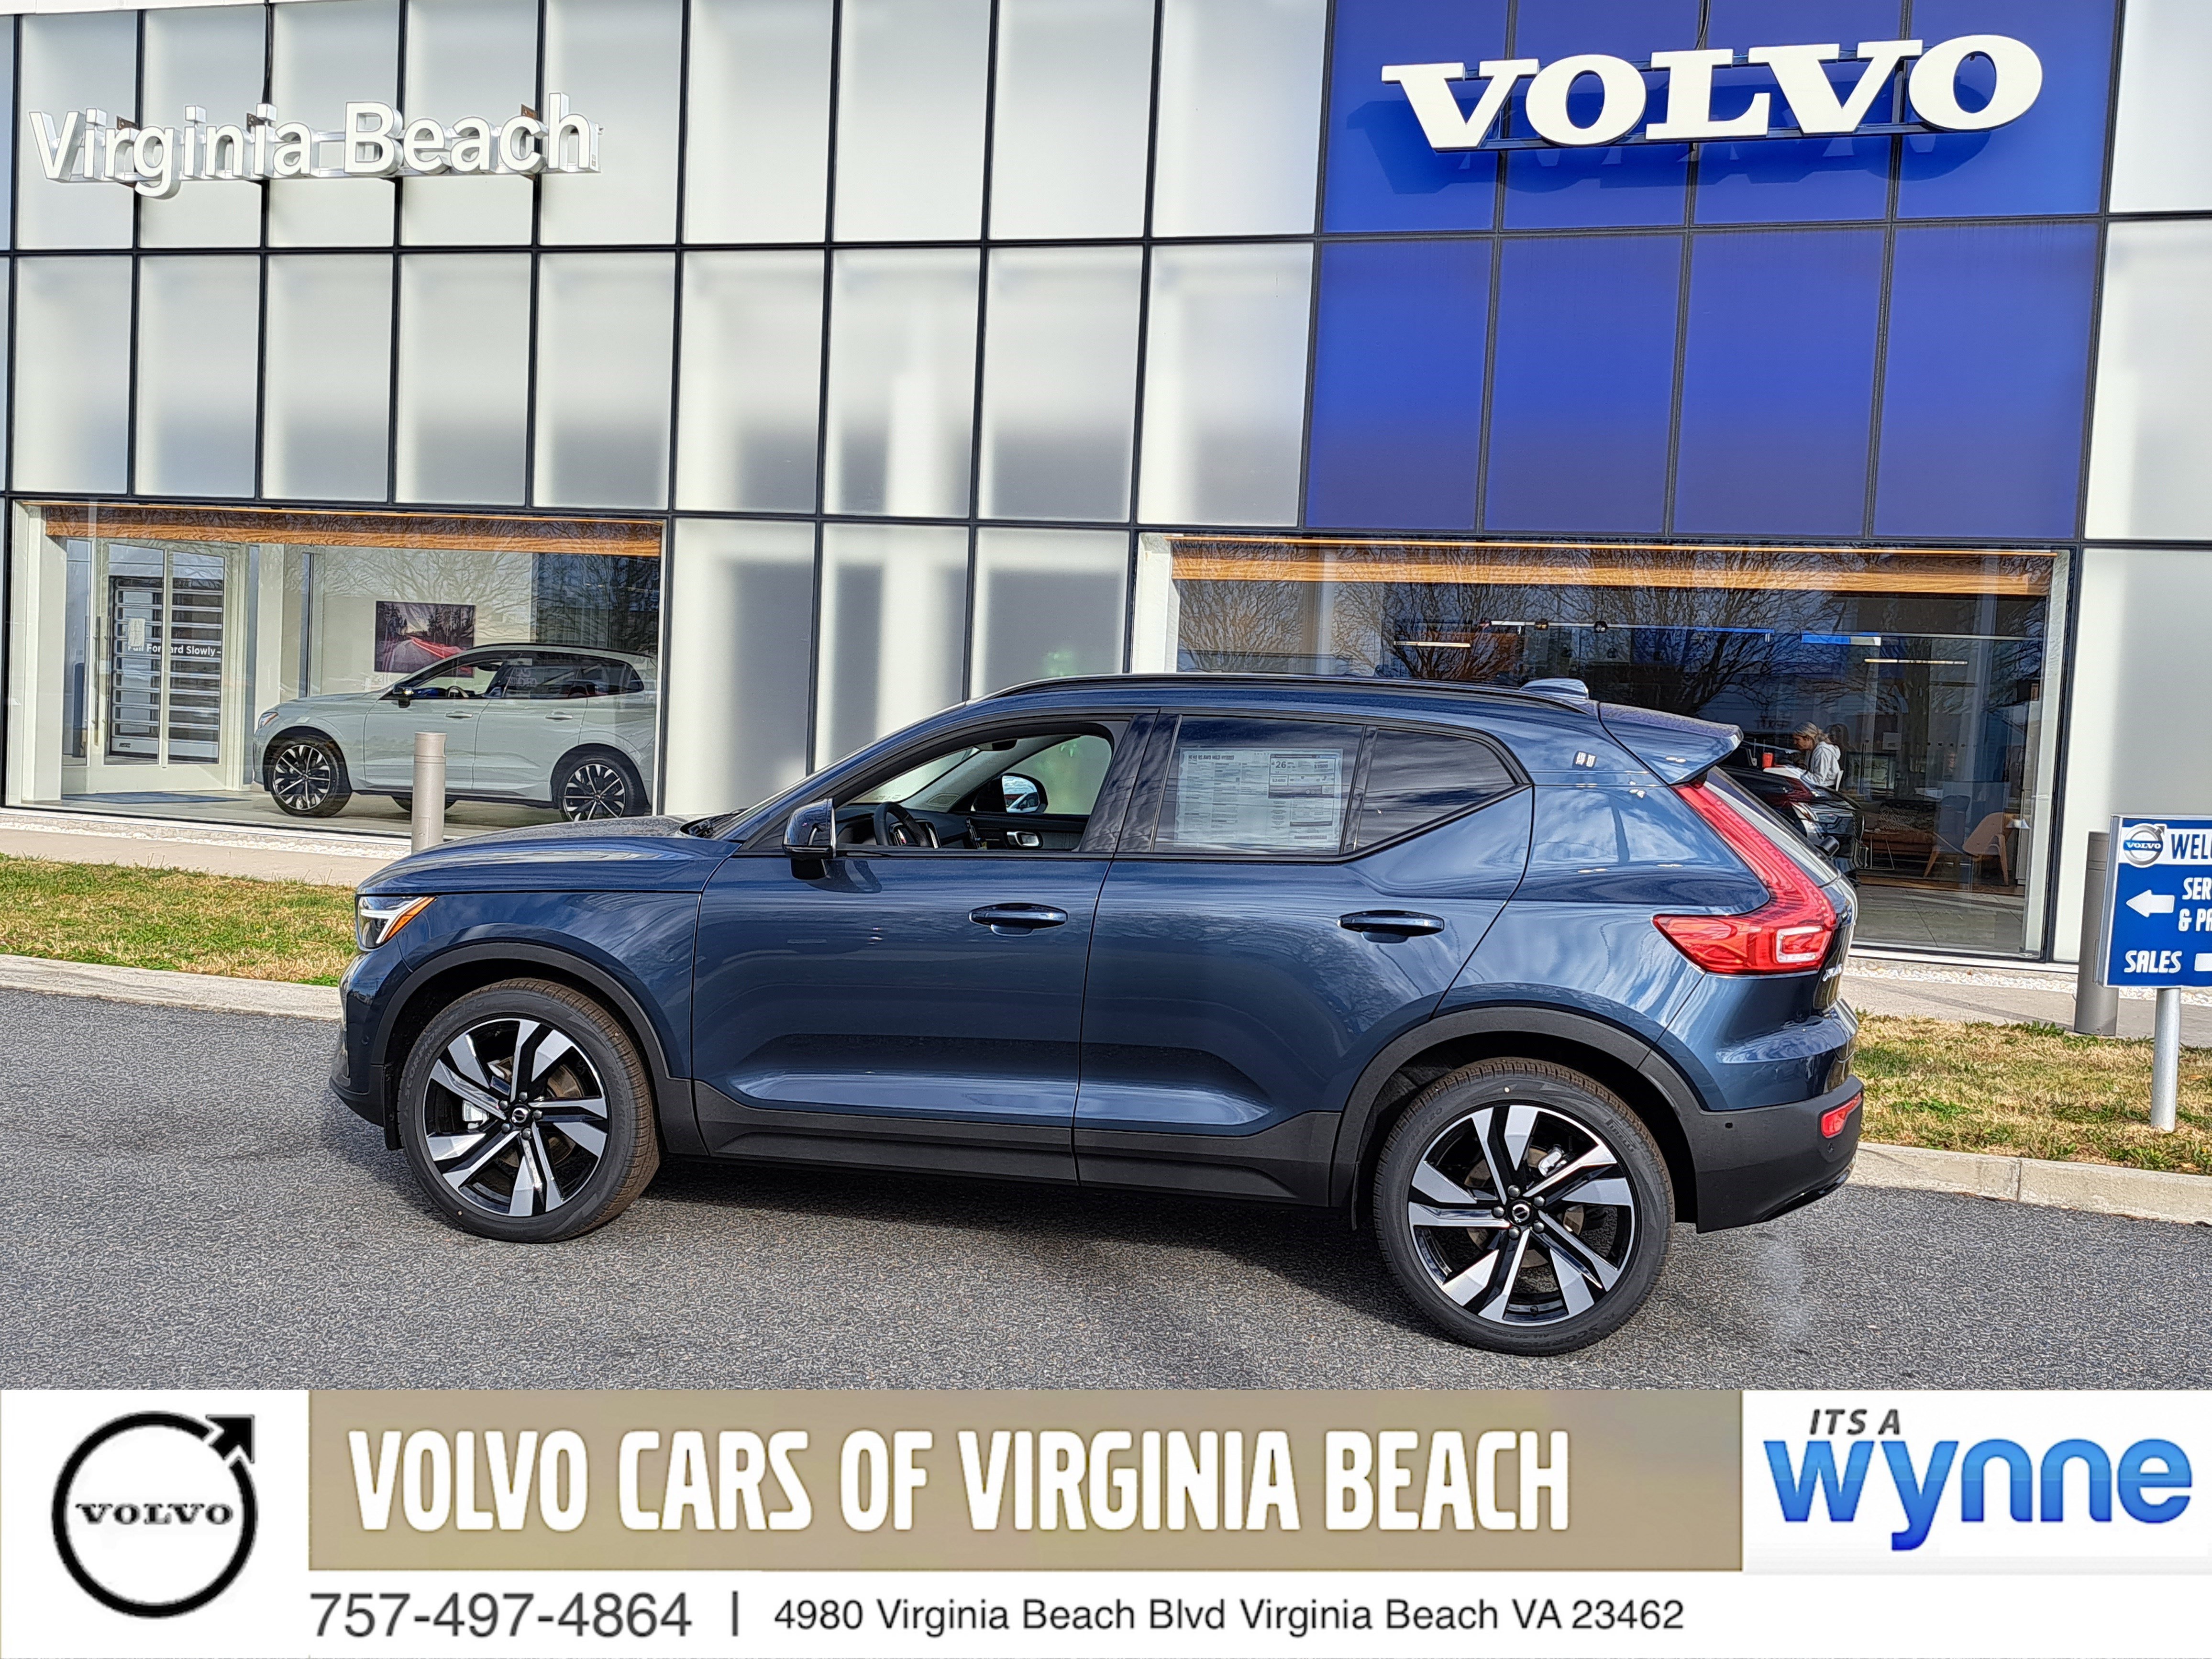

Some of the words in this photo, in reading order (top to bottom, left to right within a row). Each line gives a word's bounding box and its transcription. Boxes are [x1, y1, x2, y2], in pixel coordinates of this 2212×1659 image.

[1382, 35, 2043, 148] VOLVO
[29, 102, 314, 195] Virginia
[343, 92, 592, 175] Beach
[146, 643, 184, 653] Forard
[186, 646, 215, 656] Slowly
[2171, 834, 2212, 859] WEL
[2182, 877, 2212, 900] SER
[2178, 908, 2192, 931] &
[2124, 950, 2182, 973] SALES
[1605, 1117, 1637, 1153] PIRELLI
